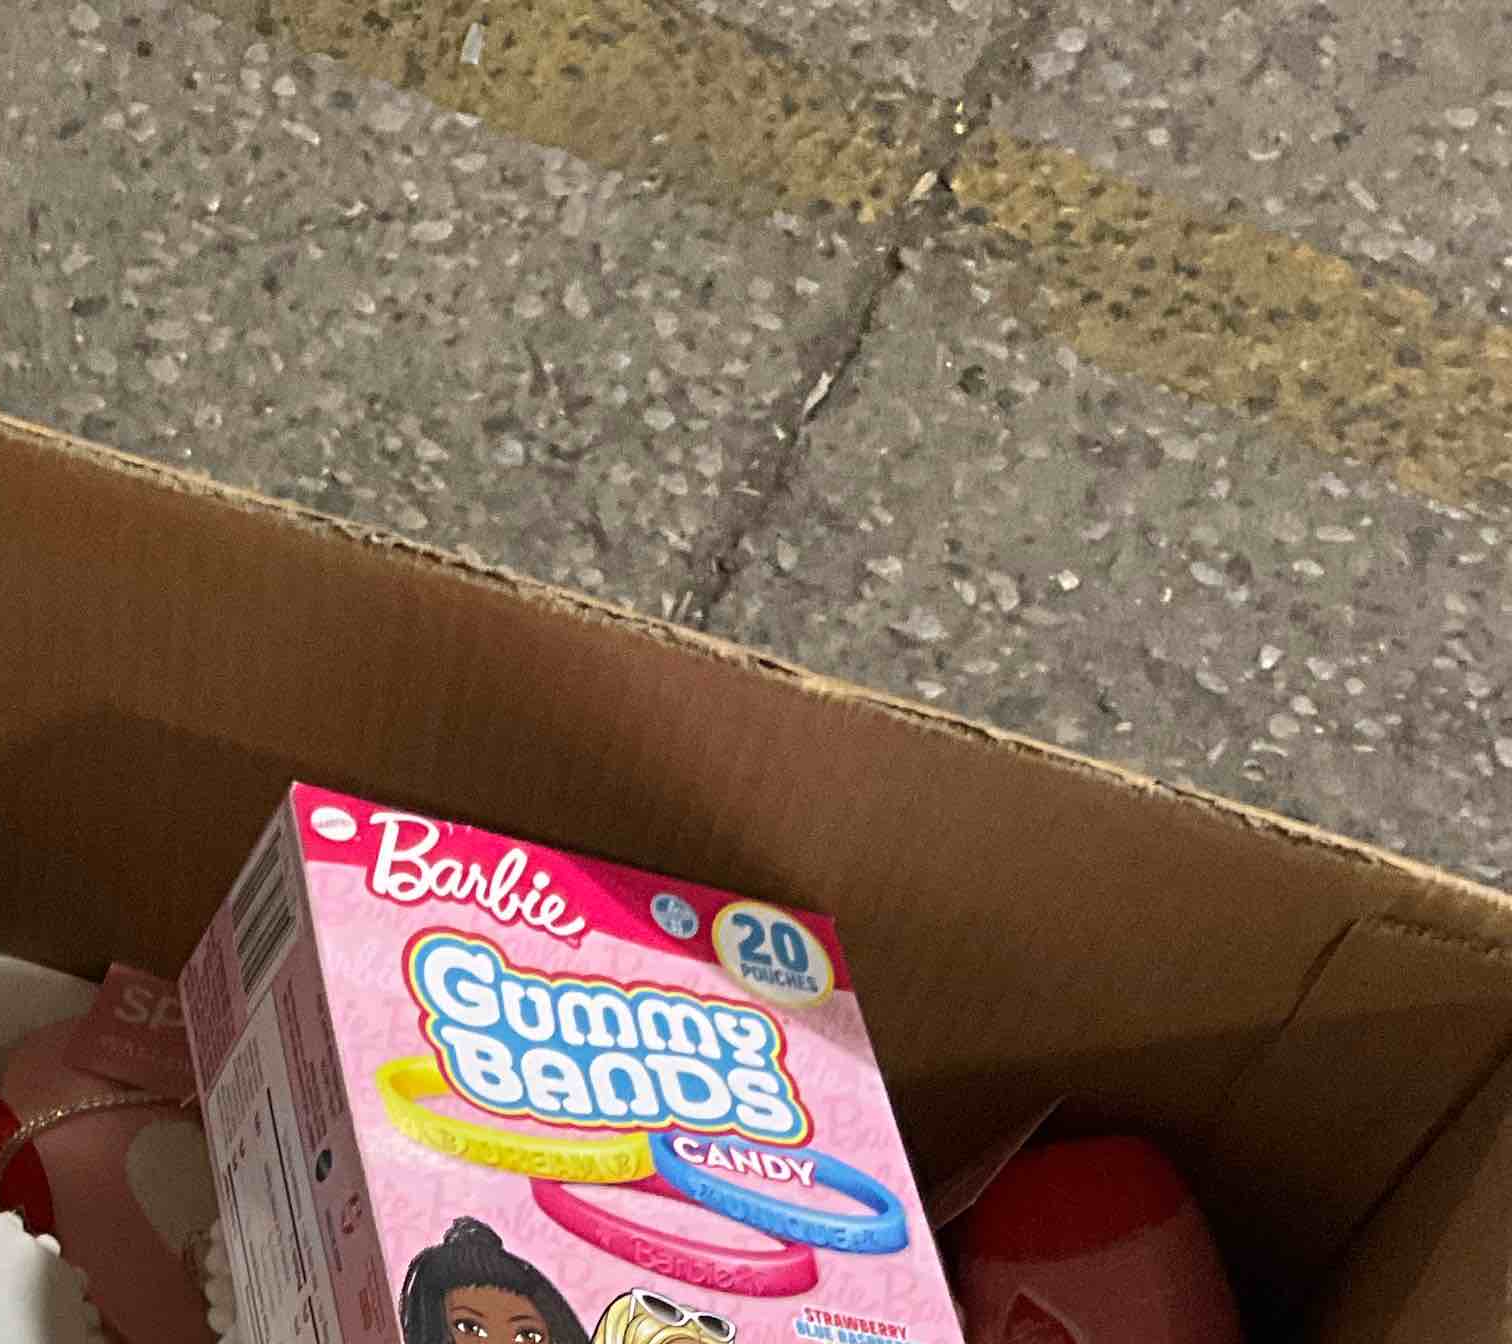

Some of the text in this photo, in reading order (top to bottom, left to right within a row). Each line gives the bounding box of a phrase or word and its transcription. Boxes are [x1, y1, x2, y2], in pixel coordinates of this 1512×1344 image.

[369, 812, 585, 936] Barbie
[732, 912, 808, 973] 20
[741, 963, 818, 993] POUCHES
[672, 1137, 816, 1187] CANDY
[796, 1320, 834, 1340] BLUE
[804, 1308, 907, 1340] STRAWBERRY
